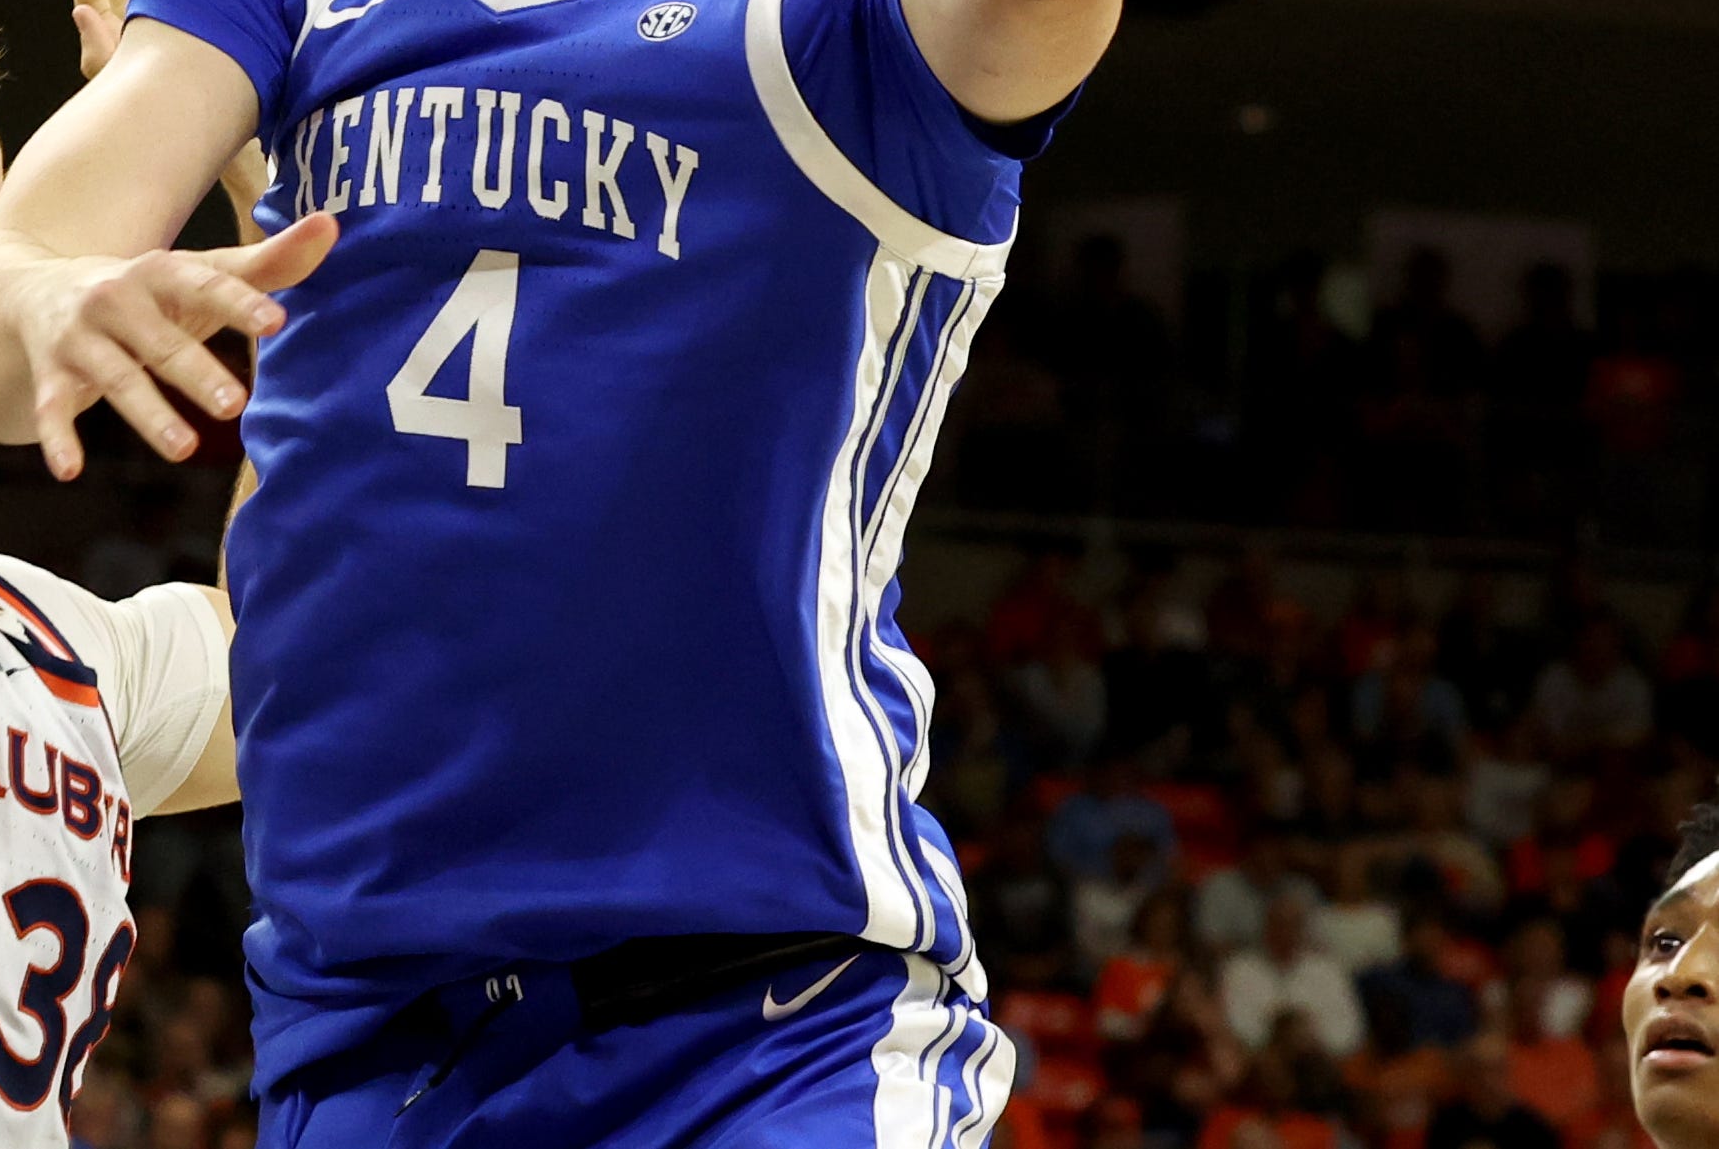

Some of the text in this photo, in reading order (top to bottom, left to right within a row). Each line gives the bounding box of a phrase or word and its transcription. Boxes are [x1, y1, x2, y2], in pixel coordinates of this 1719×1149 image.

[639, 4, 693, 39] SEC
[294, 85, 699, 261] KENTUCKY
[385, 248, 523, 489] 4
